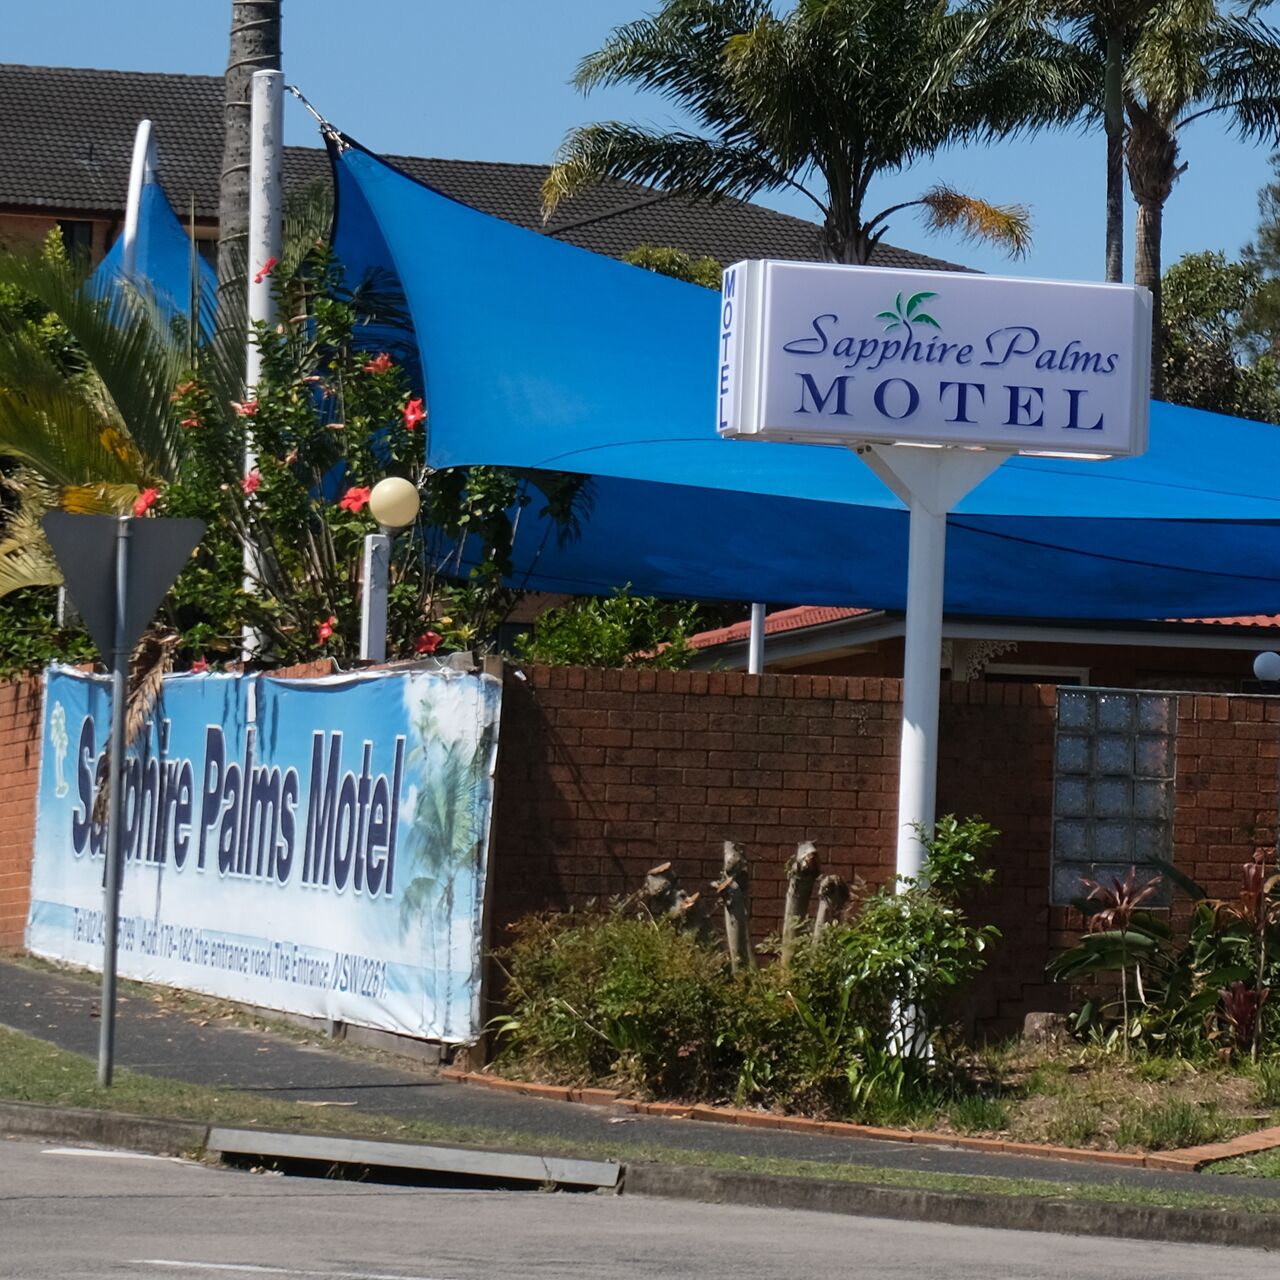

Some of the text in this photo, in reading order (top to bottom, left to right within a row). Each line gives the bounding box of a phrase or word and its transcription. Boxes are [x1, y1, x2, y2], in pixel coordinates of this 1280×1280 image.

[720, 270, 736, 429] MOTEL
[782, 314, 1120, 374] Sapphire Palms
[794, 372, 1105, 431] MOTEL
[72, 714, 406, 899] Saphire Palms Motel
